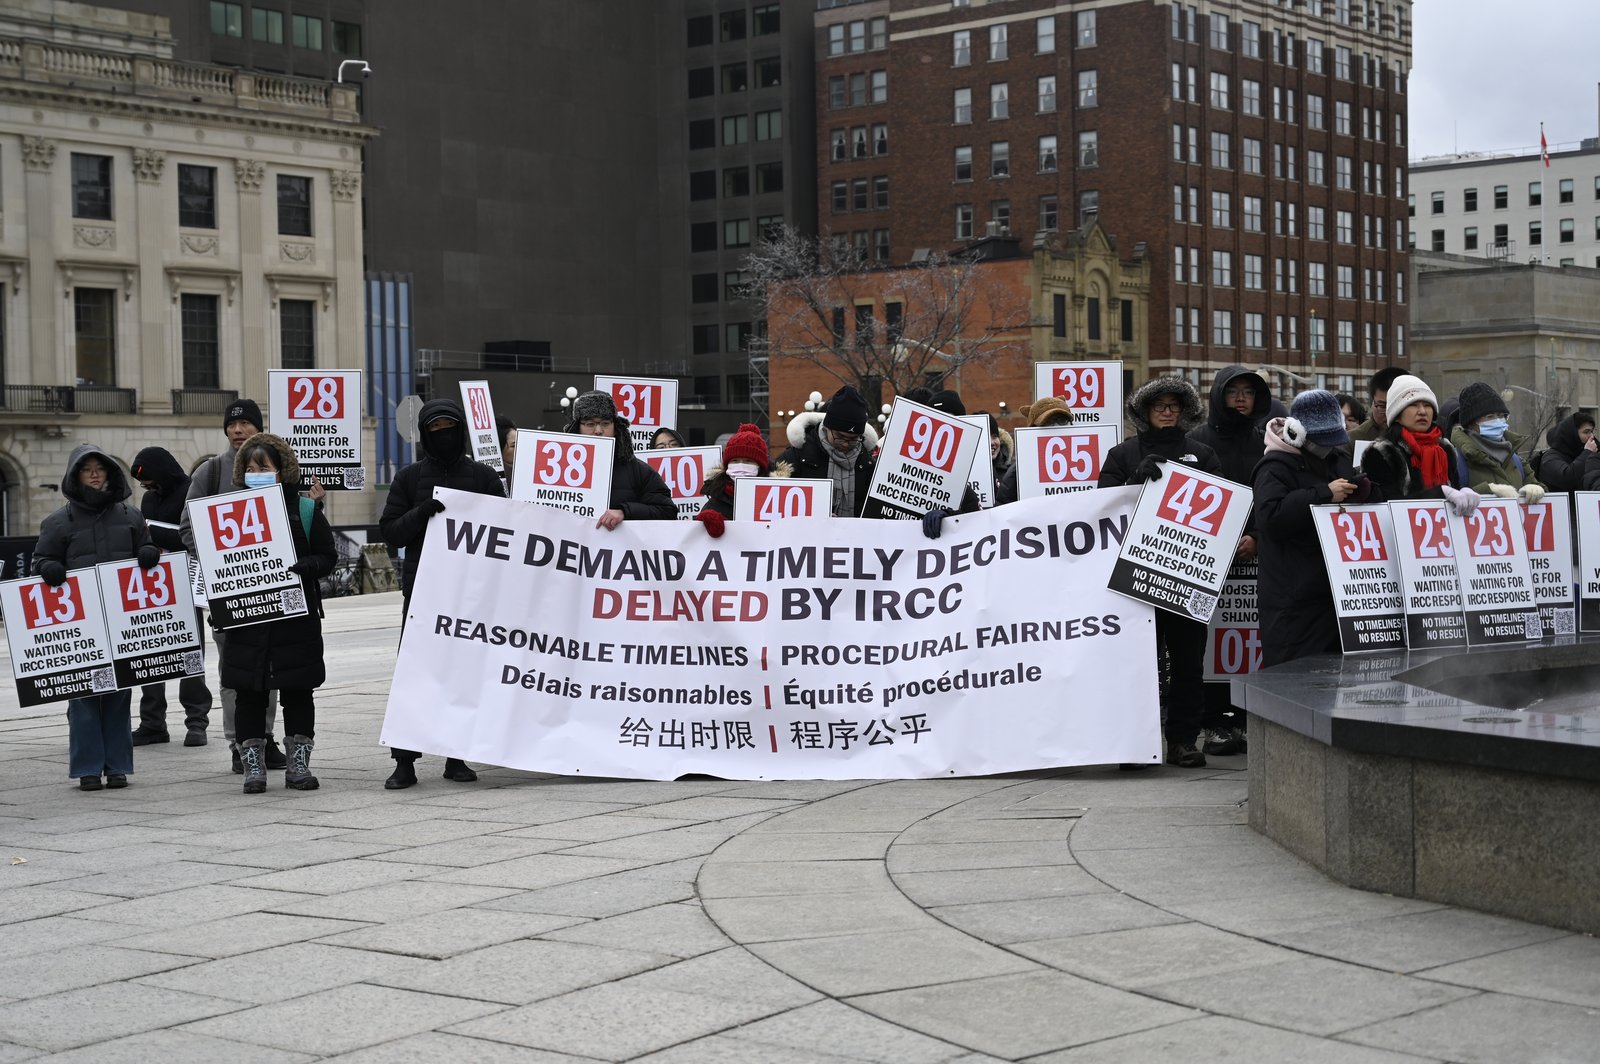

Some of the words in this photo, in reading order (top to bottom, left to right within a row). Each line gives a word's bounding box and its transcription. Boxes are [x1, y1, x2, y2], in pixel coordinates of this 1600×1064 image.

[1058, 368, 1099, 408] 39
[293, 377, 338, 418] 28
[618, 384, 655, 426] 31
[470, 388, 490, 429] 30
[1072, 413, 1100, 422] NTHS
[293, 425, 337, 434] MONTHS
[631, 431, 653, 440] NTHS
[329, 437, 349, 446] FOR
[908, 415, 955, 468] 90
[300, 449, 355, 458] RESPONSE
[1045, 436, 1093, 482] 65
[300, 467, 344, 475] TIMELINES
[539, 442, 588, 487] 38
[304, 477, 340, 485] REULTS
[658, 456, 698, 497] 40
[900, 463, 944, 486] MONTHS
[536, 489, 584, 503] MONTHS
[876, 483, 899, 500] IRCC
[887, 472, 928, 496] WAITING
[930, 490, 951, 503] FOR
[573, 506, 595, 517] FOR
[759, 486, 807, 521] 40
[881, 505, 894, 517] NO
[1166, 477, 1223, 533] 42
[215, 498, 265, 548] 54
[1468, 507, 1508, 556] 23
[1157, 524, 1208, 550] MONTHS
[1337, 512, 1382, 561] 34
[1415, 508, 1454, 558] 23
[223, 547, 269, 564] MONTHS
[446, 518, 515, 561] WE
[523, 533, 686, 582] DEMAND
[696, 550, 728, 582] A
[741, 546, 904, 582] TIMELY
[916, 514, 1128, 579] DECISION
[1141, 533, 1190, 560] WAITING
[1190, 551, 1216, 569] FOR
[215, 562, 260, 579] WAITING
[262, 558, 284, 571] FOR
[1128, 544, 1154, 562] IRCC
[1154, 554, 1218, 585] RESPONSE
[1476, 562, 1513, 575] MONTHS
[1530, 558, 1549, 570] THS
[1349, 567, 1387, 580] MONTHS
[1542, 572, 1561, 583] FOR
[126, 565, 170, 609] 43
[211, 580, 236, 594] IRCC
[235, 571, 293, 591] RESPONSE
[1132, 568, 1148, 581] NO
[1147, 573, 1193, 597] TIMELINE
[1343, 583, 1380, 596] WAITING
[1381, 581, 1400, 594] FOR
[1414, 579, 1453, 593] WAITING
[1470, 577, 1506, 591] WAITING
[1507, 576, 1524, 588] FOR
[1132, 581, 1148, 594] NO
[1147, 586, 1190, 608] RESULTS
[1467, 593, 1487, 606] IRCC
[1487, 590, 1531, 604] RESPONSE
[1535, 586, 1568, 598] PONSE
[28, 581, 76, 627] 13
[225, 599, 239, 610] NO
[592, 587, 769, 622] DELAYED
[781, 587, 842, 621] BY
[855, 582, 963, 621] IRCC
[1217, 598, 1230, 609] FO
[1340, 599, 1361, 611] IRCC
[1410, 595, 1431, 608] IRCC
[1432, 594, 1462, 607] RESPO
[130, 610, 173, 626] MONTHS
[232, 608, 245, 619] NO
[246, 603, 284, 617] RESULTS
[1222, 611, 1258, 622] ONTHS
[1479, 614, 1490, 625] NO
[1490, 612, 1525, 624] TIMELINES
[121, 624, 164, 640] WAITING
[166, 620, 186, 634] FOR
[1354, 620, 1366, 631] NO
[1365, 618, 1401, 630] TIMELINES
[1422, 618, 1433, 628] NO
[1434, 616, 1463, 627] TIMELIN
[1484, 626, 1495, 637] NO
[1495, 624, 1525, 637] RESULTS
[34, 627, 81, 645] MONTHS
[435, 614, 615, 663] REASONABLE
[621, 644, 749, 667] TIMELINES
[781, 631, 968, 666] PROCEDURAL
[976, 614, 1121, 649] FAIRNESS
[1358, 633, 1370, 644] NO
[1370, 630, 1400, 643] RESULTS
[1427, 630, 1437, 640] NO
[1439, 628, 1465, 640] RESULT
[24, 642, 72, 659] WAITING
[74, 638, 96, 651] FOR
[117, 639, 145, 654] IRCC
[144, 632, 193, 651] RESPONSE
[1221, 629, 1264, 674] 40
[20, 658, 50, 673] IRCC
[50, 649, 105, 670] RESPONSE
[130, 658, 143, 670] NO
[135, 668, 148, 680] NO
[149, 663, 184, 677] RESULTS
[34, 677, 47, 689] NO
[40, 686, 53, 698] NO
[54, 682, 93, 696] RESULTS
[501, 664, 582, 698] Délais
[590, 681, 752, 706] raisonnables
[783, 678, 873, 709] Équité
[883, 662, 1042, 707] procédurale
[618, 716, 756, 751] 给出时限
[790, 713, 932, 752] 程序公平
